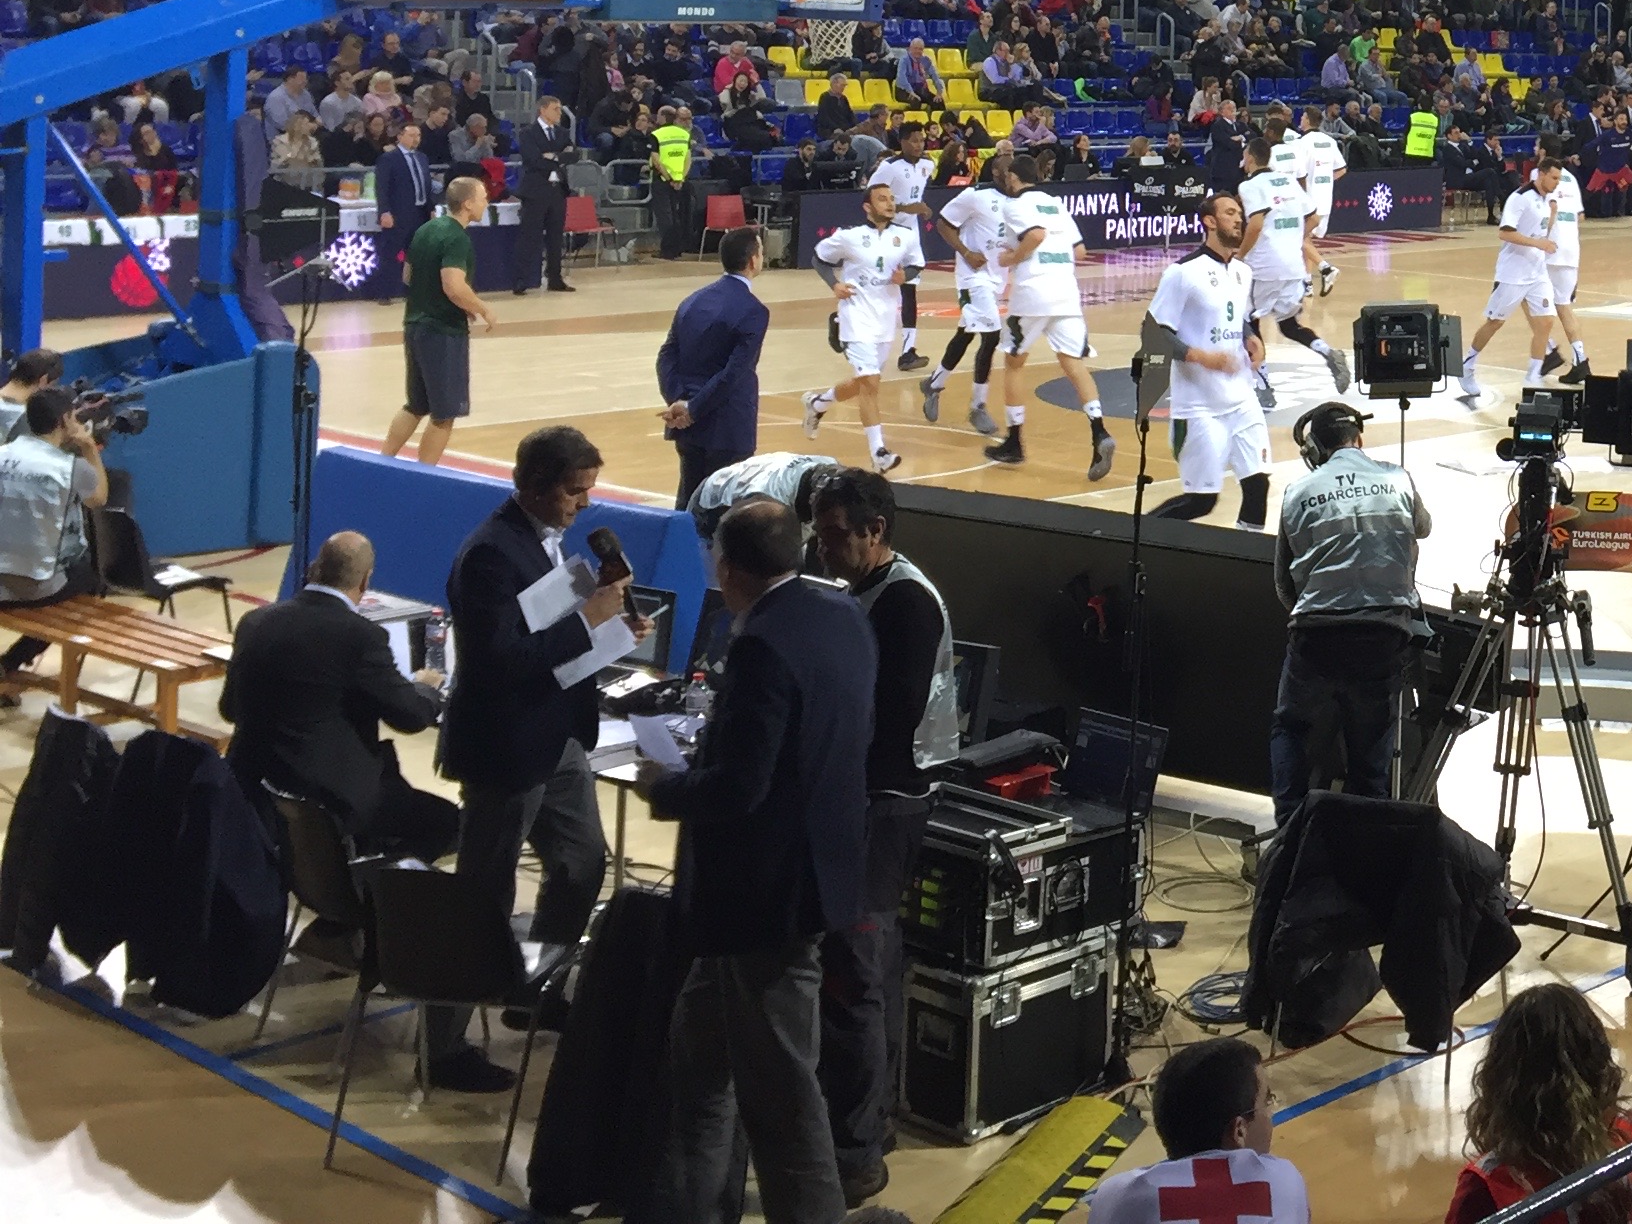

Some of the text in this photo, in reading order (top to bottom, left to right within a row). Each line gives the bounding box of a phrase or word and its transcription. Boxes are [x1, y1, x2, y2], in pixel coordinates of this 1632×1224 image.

[677, 7, 715, 16] MONDO
[1064, 192, 1120, 216] UANYA
[876, 256, 884, 272] 4
[1226, 301, 1234, 322] 9
[1335, 473, 1356, 487] TV
[1301, 483, 1397, 512] FCBARCELONA
[1572, 530, 1613, 540] TURKISH
[1572, 538, 1631, 551] EuroLeague
